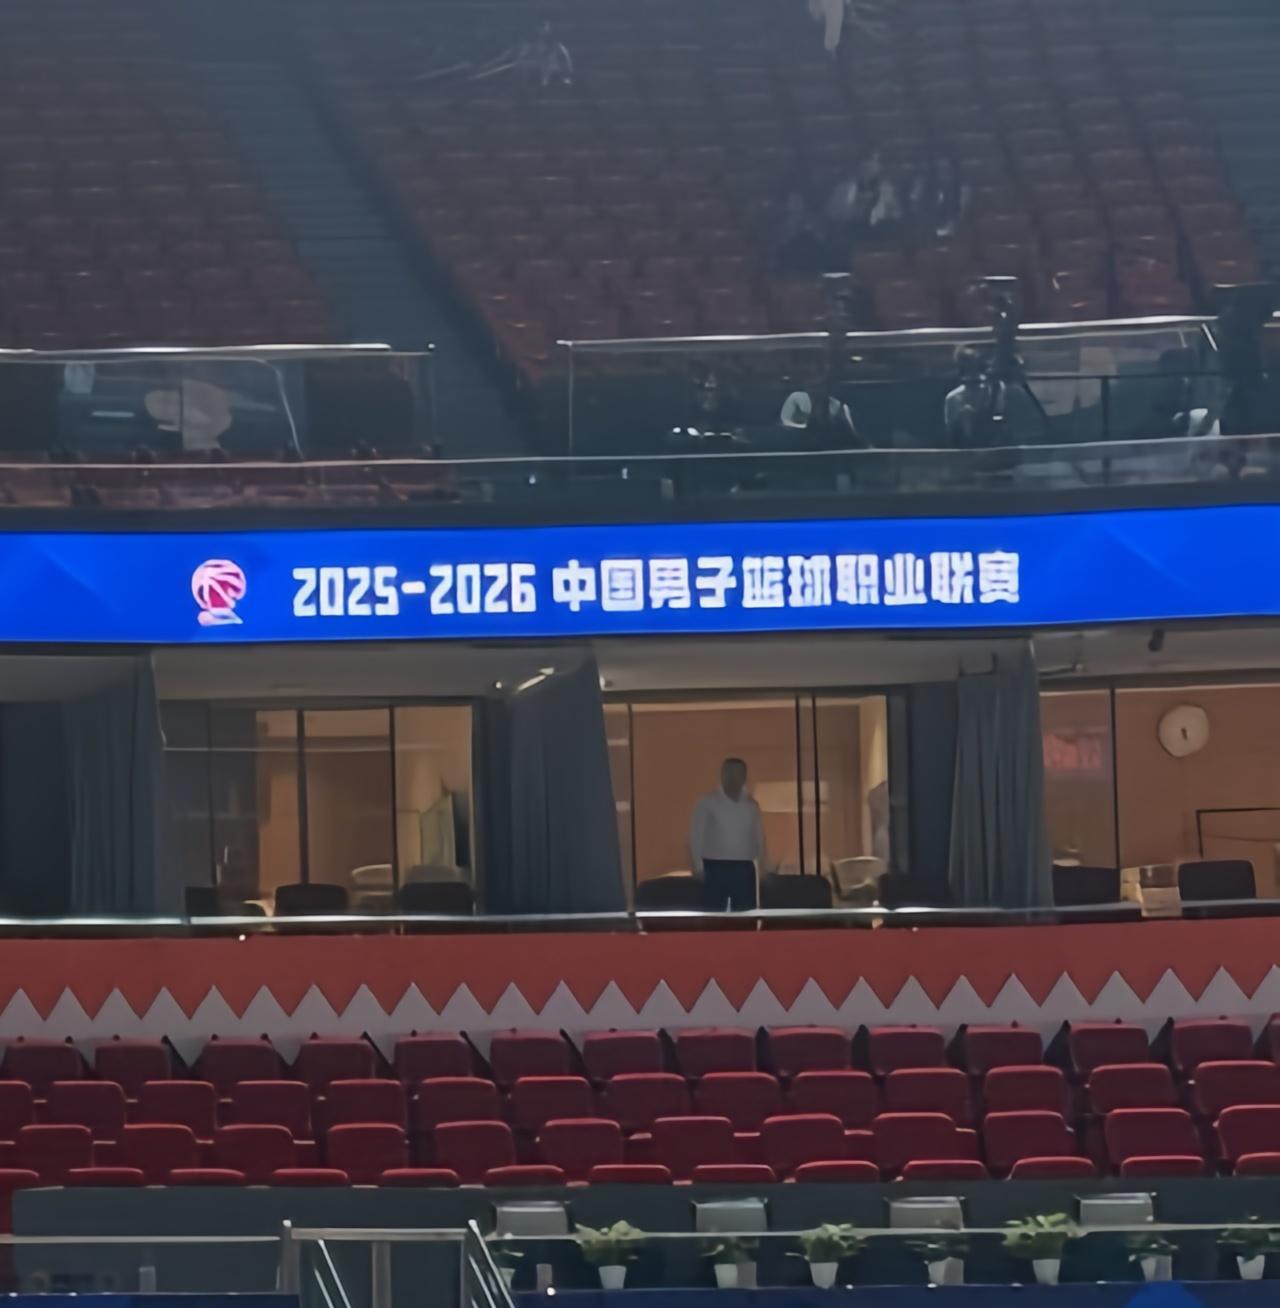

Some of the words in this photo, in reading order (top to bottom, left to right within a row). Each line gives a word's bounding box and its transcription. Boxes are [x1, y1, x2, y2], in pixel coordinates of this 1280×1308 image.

[292, 562, 537, 617] 2025-2026
[552, 550, 1020, 612] 中国男子篮球职业联赛
